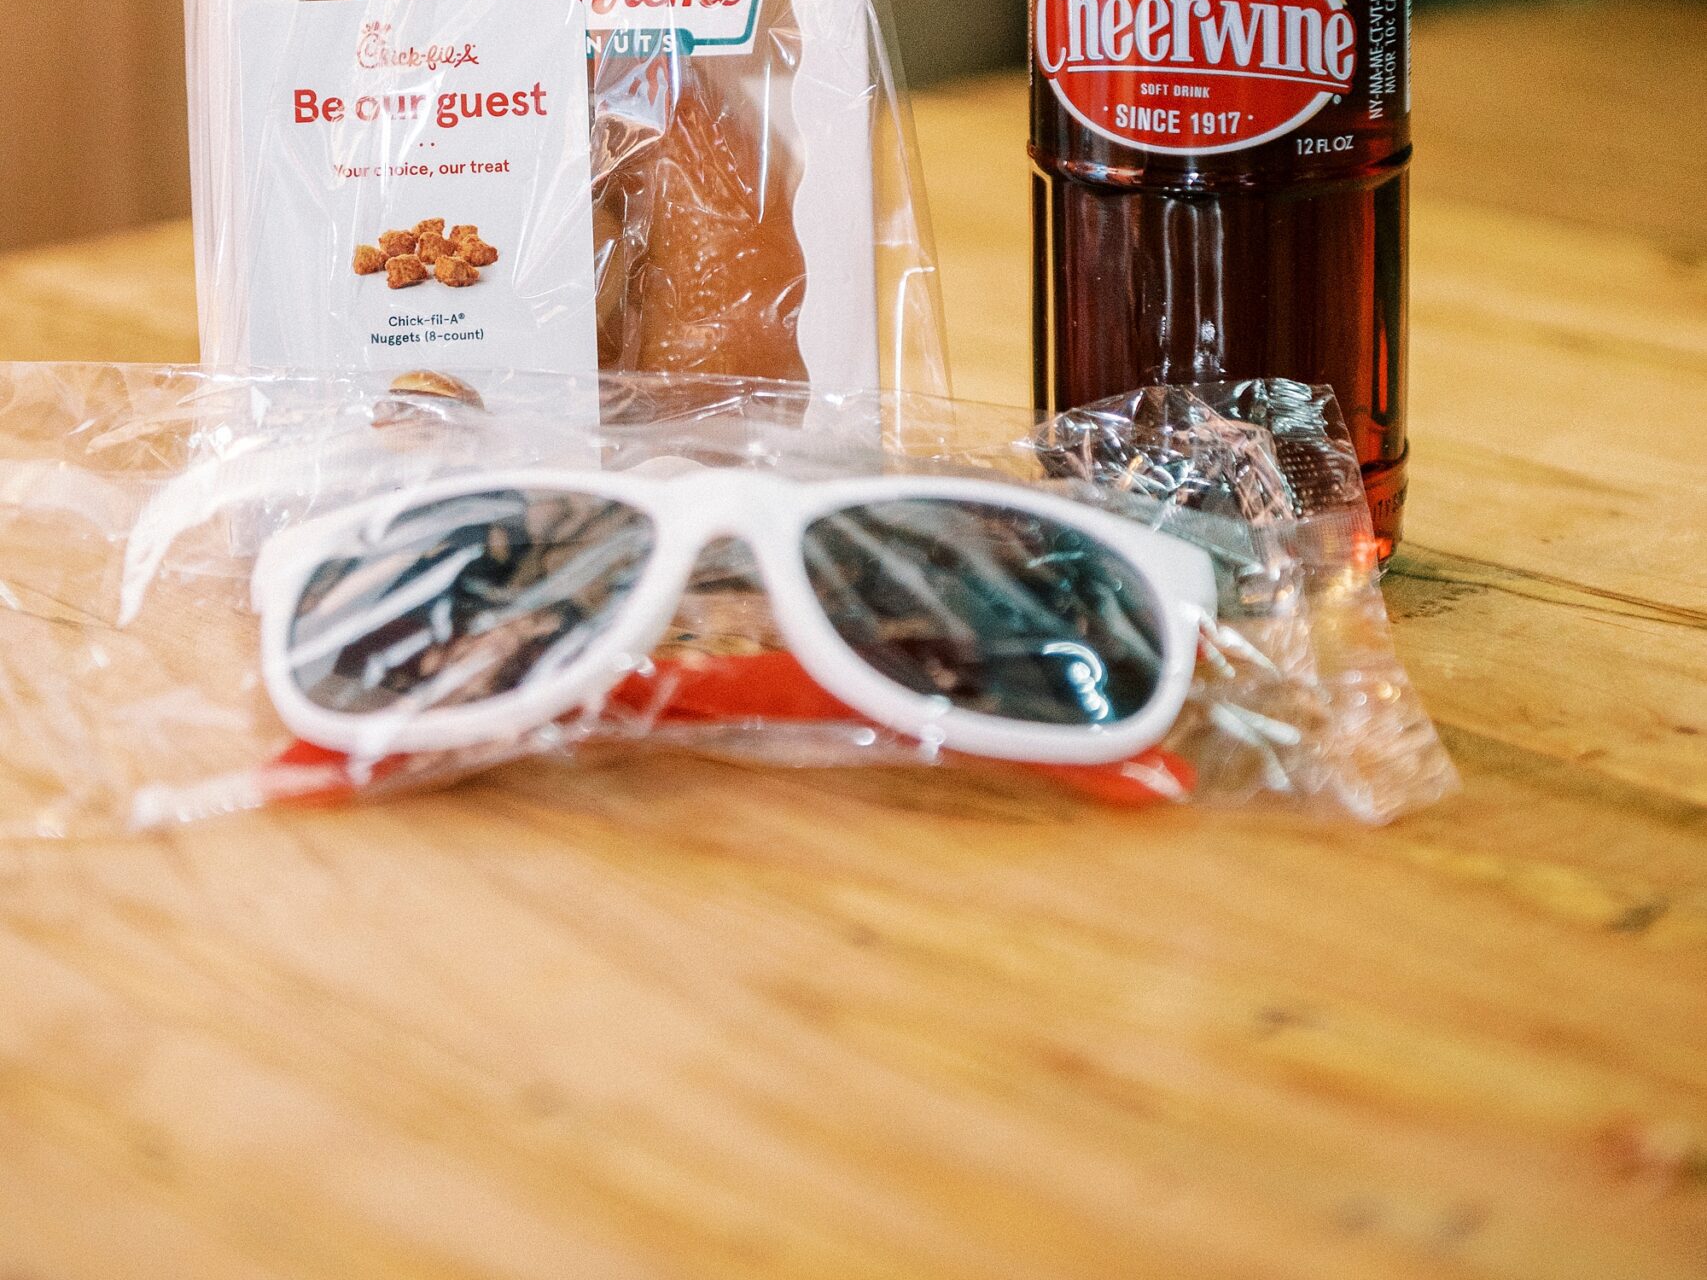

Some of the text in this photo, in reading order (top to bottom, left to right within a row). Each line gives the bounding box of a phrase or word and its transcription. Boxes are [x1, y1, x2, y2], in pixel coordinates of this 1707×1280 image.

[1385, 50, 1397, 94] MI-OR
[1140, 82, 1210, 99] SOFT DRINK
[294, 81, 548, 129] Be our guest
[1116, 103, 1241, 135] SINCE 1917
[1296, 135, 1354, 155] 12 FL OZ
[333, 158, 510, 178] Your choice, our treat
[370, 328, 484, 346] Nuggets (8-count)
